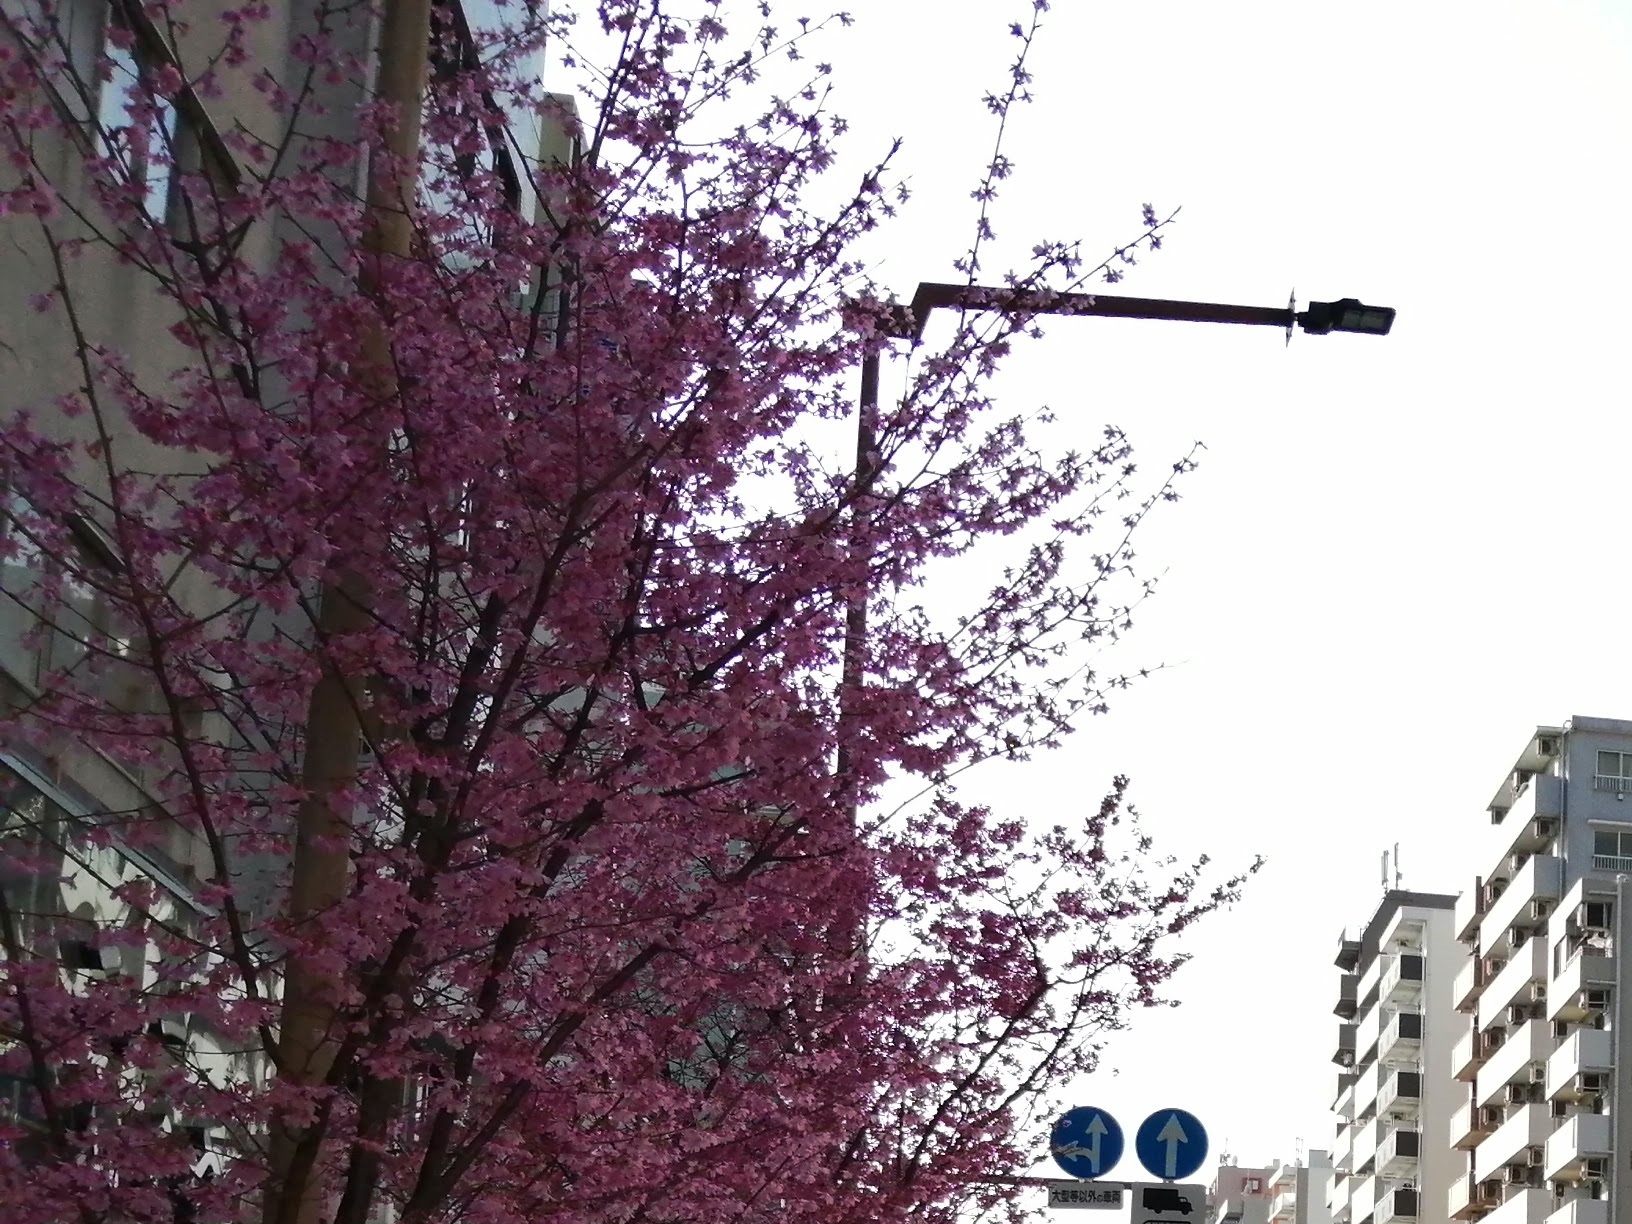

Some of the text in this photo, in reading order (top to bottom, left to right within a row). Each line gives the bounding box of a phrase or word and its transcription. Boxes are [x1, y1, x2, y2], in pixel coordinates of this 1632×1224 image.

[1052, 1189, 1121, 1204] 大型等以外の車両
